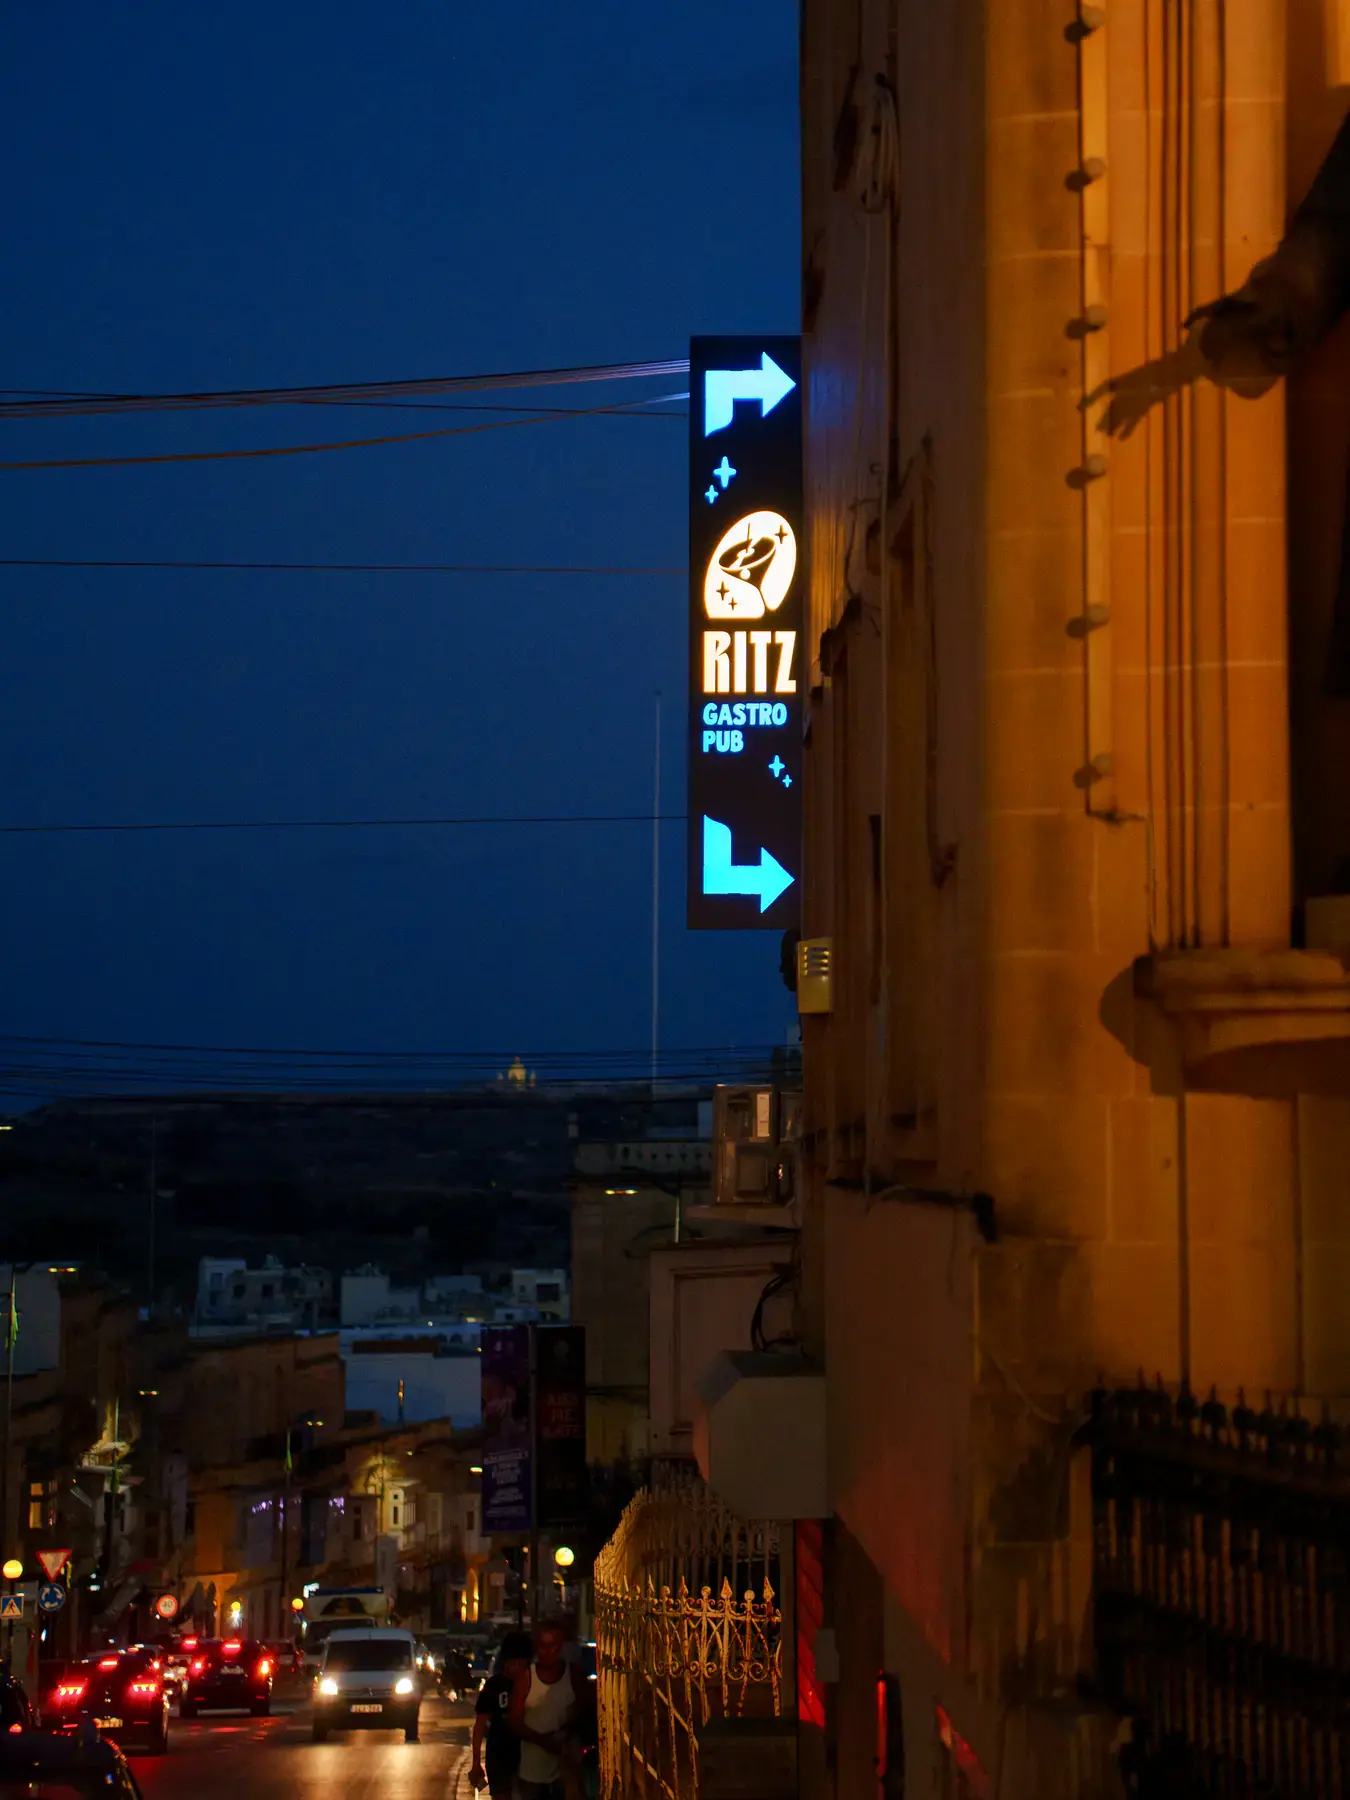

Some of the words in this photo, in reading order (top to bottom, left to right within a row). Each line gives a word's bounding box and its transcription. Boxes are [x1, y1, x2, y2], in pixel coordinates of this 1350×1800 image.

[703, 630, 797, 693] RITZ
[702, 702, 788, 726] GASTRO
[702, 729, 745, 753] PUB
